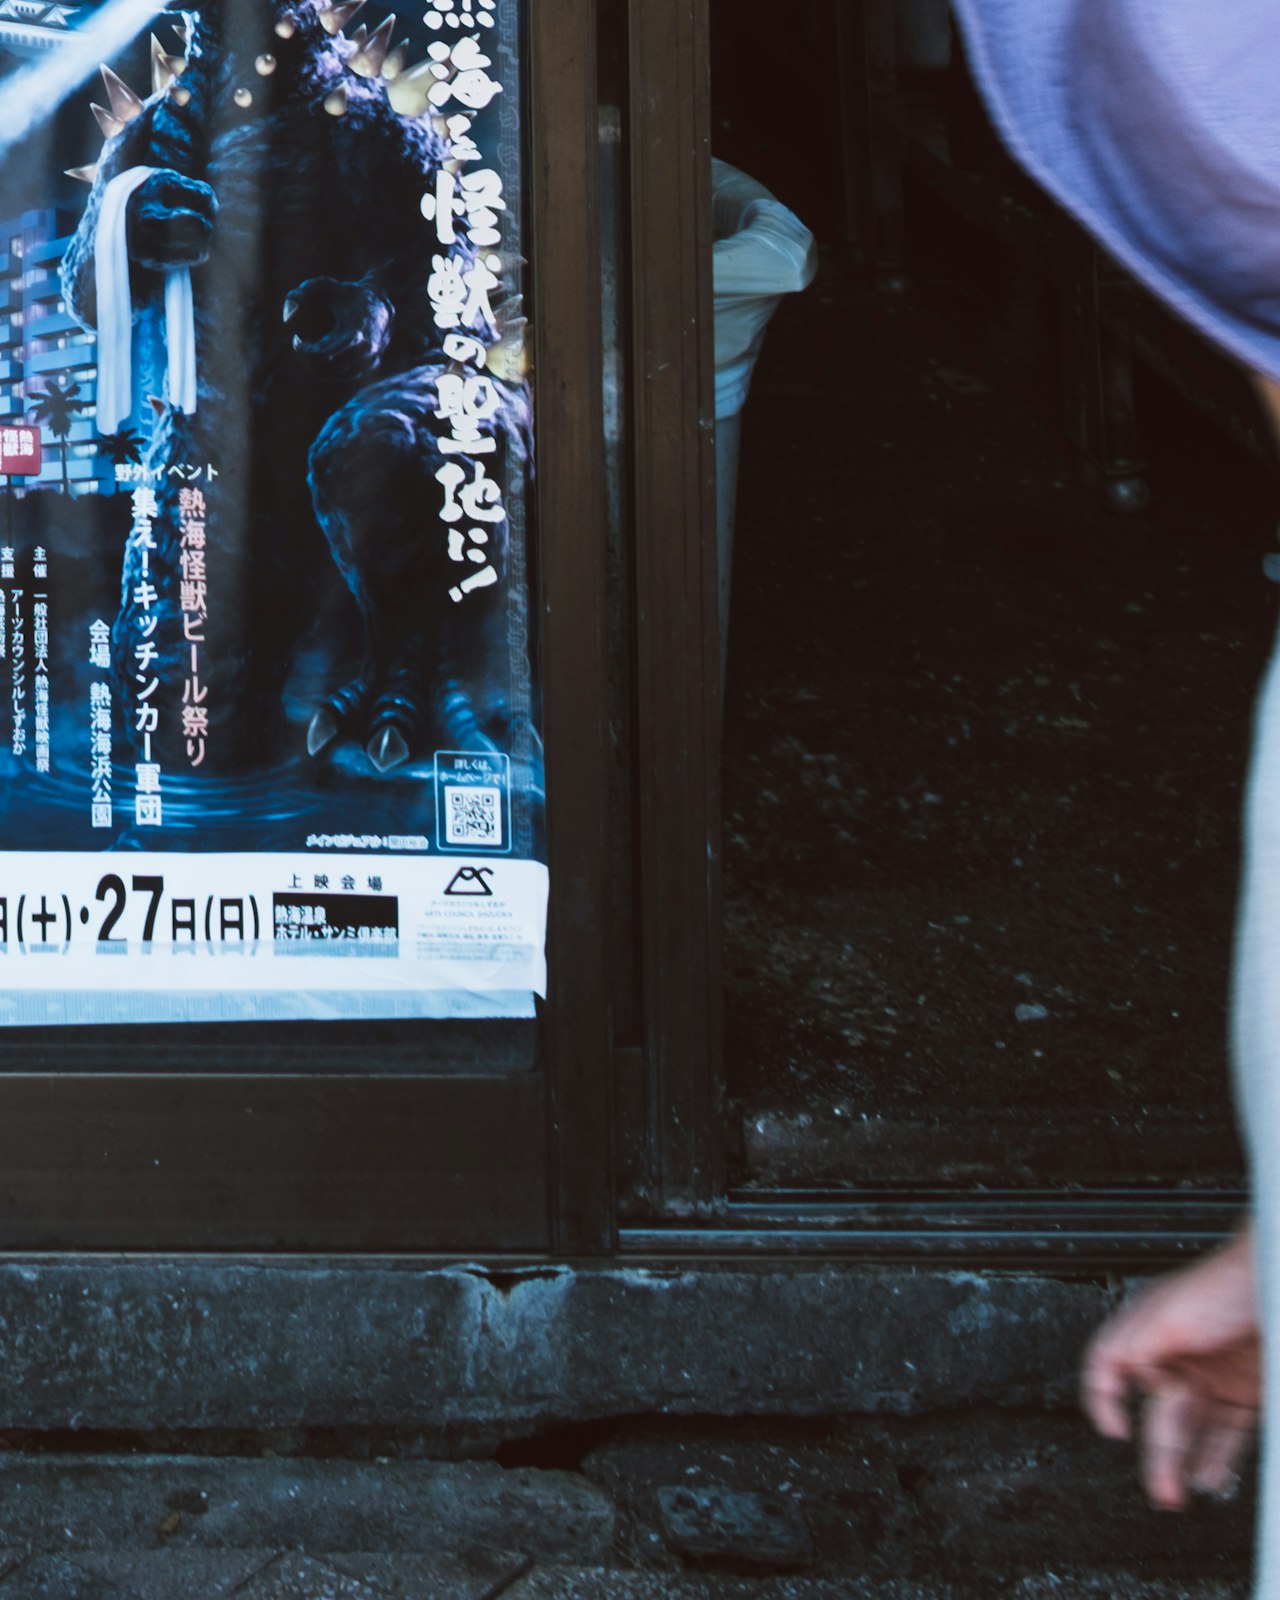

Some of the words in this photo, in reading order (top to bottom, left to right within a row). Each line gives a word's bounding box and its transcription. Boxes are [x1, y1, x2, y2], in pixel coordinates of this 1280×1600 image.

[114, 462, 219, 483] 野外イベント
[0, 546, 15, 579] 支援
[32, 546, 48, 579] 主催
[88, 618, 111, 669] 会場
[178, 486, 209, 768] 熱海怪獣ビール祭り
[10, 588, 26, 757] アーツカウンシルしずおか
[90, 681, 113, 829] 熱海海浜公園
[288, 873, 383, 892] 上映会場
[274, 904, 327, 926] 熱海温泉
